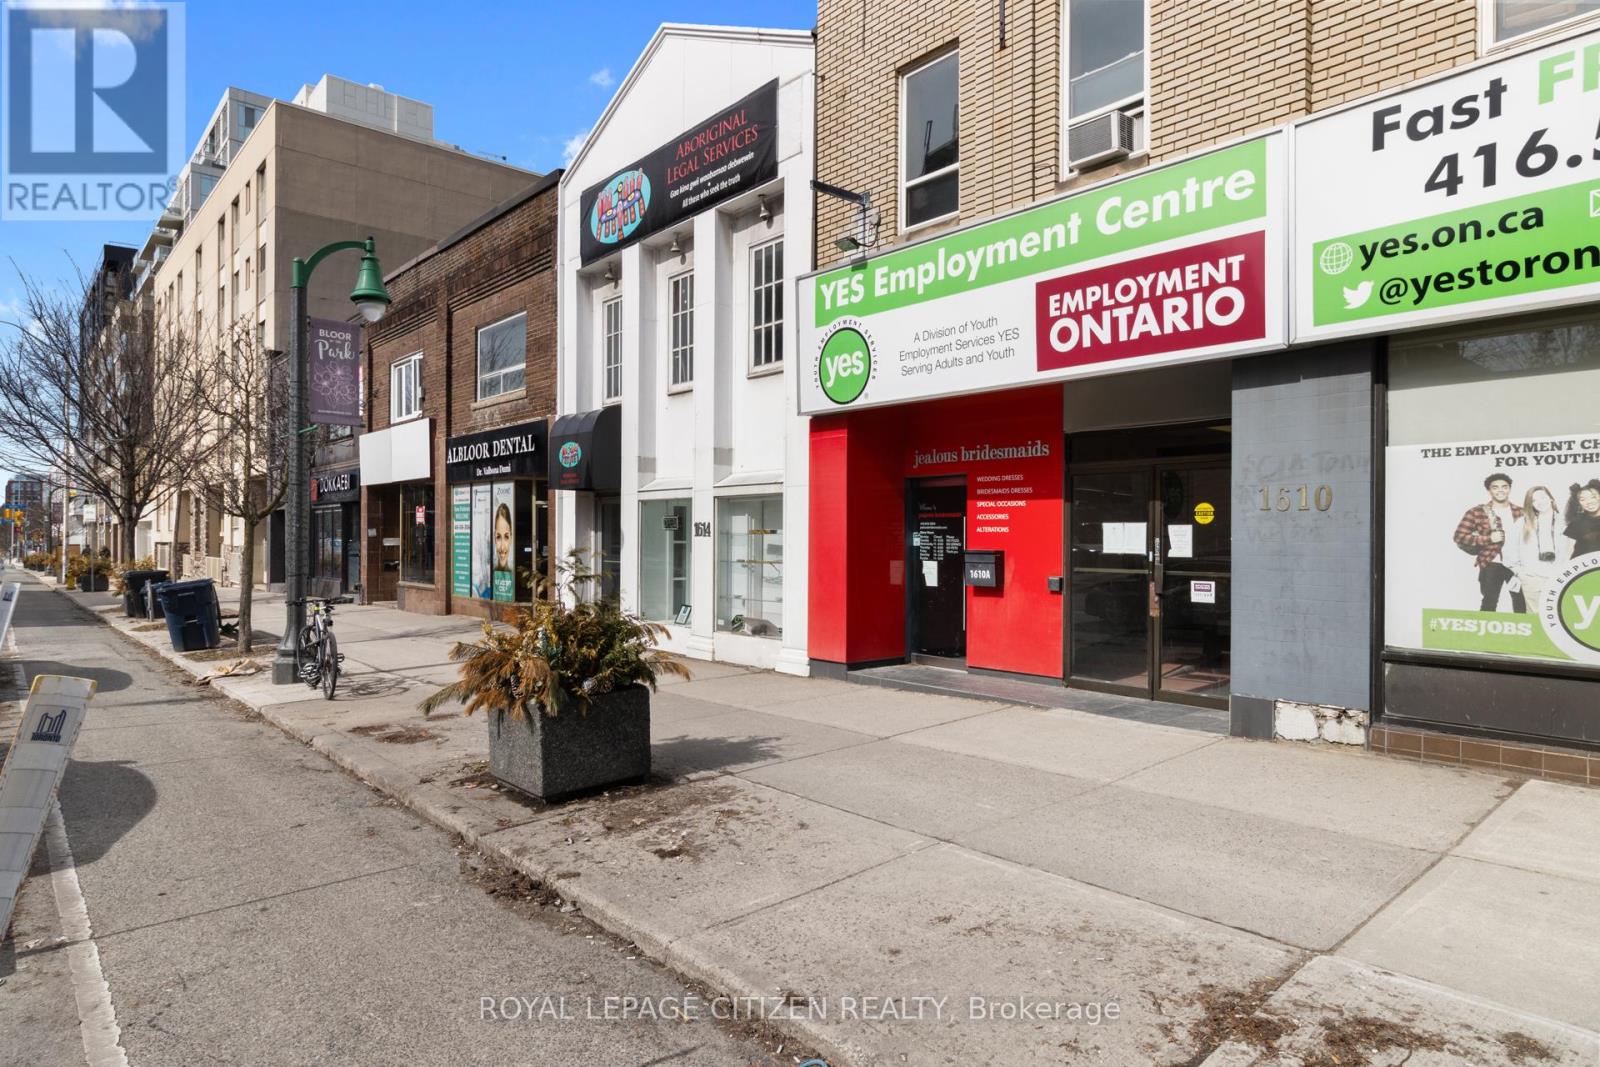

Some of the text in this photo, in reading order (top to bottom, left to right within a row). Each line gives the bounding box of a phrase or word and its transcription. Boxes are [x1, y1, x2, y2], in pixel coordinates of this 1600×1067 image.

[1372, 77, 1508, 152] Fast
[676, 110, 747, 160] ABORIGINAL
[667, 124, 759, 184] LEGAL SERVICES
[1424, 114, 1600, 197] 416.
[820, 169, 1256, 310] YES Employment Centre
[1359, 206, 1543, 271] yes.on.ca
[1049, 254, 1245, 317] EMPLOYMENT
[914, 316, 998, 343] A Division of Youth
[1050, 286, 1245, 352] ONTARIO
[314, 339, 355, 360] Park
[319, 329, 352, 341] BLOOR
[899, 327, 1020, 361] Employment Services YES
[825, 350, 864, 388] yes
[901, 346, 1015, 377] Serving Adults and Youth
[447, 434, 535, 464] ALBLOOR DENTAL
[912, 440, 1050, 469] jealous bridesmaids
[1421, 448, 1451, 458] THE
[1455, 440, 1575, 457] EMPLOYMENT
[1495, 452, 1600, 467] FOR YOUTH!
[976, 487, 1010, 495] BRIDESMAIDS
[1258, 483, 1333, 513] 1610
[969, 569, 991, 580] 1610A
[1546, 589, 1557, 628] YOUTH
[1430, 616, 1532, 637] #YESJOBS
